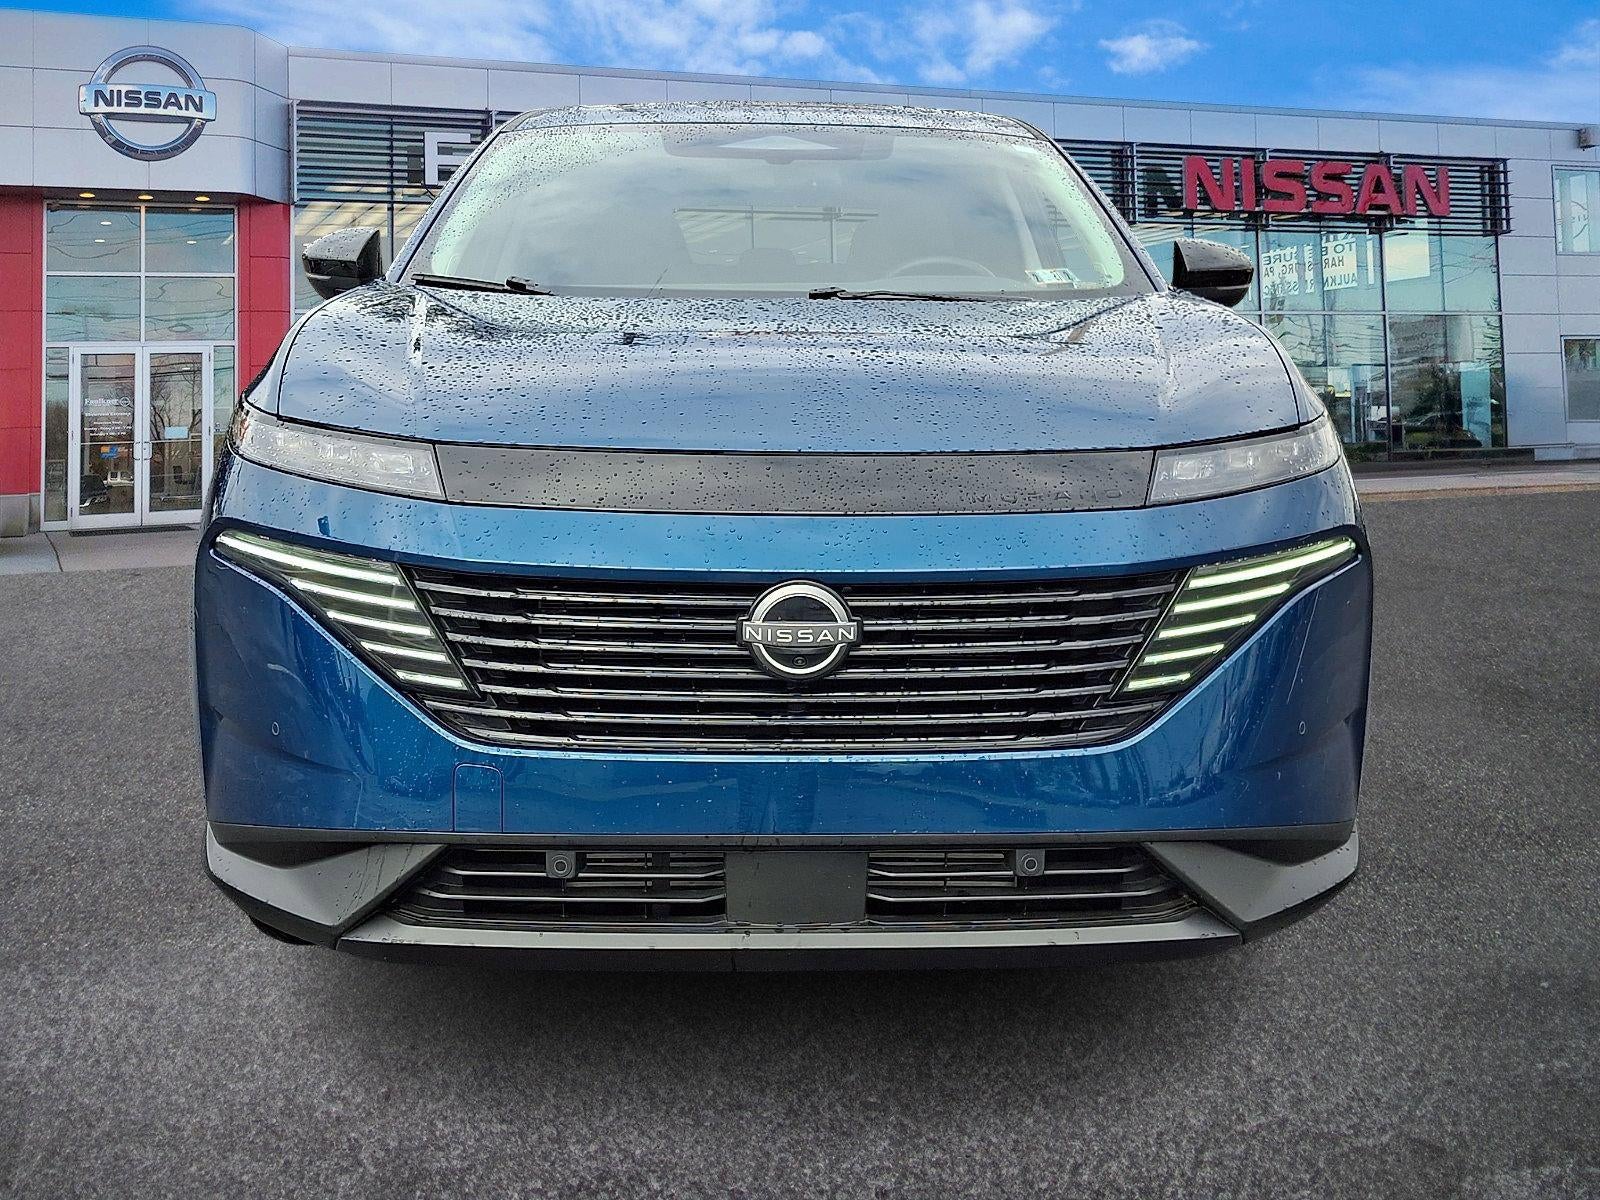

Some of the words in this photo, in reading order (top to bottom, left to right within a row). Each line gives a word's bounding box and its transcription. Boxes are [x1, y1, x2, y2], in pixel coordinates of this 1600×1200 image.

[94, 89, 204, 113] NISSAN
[1182, 155, 1451, 217] NISSAN
[745, 626, 855, 643] NISSAN
